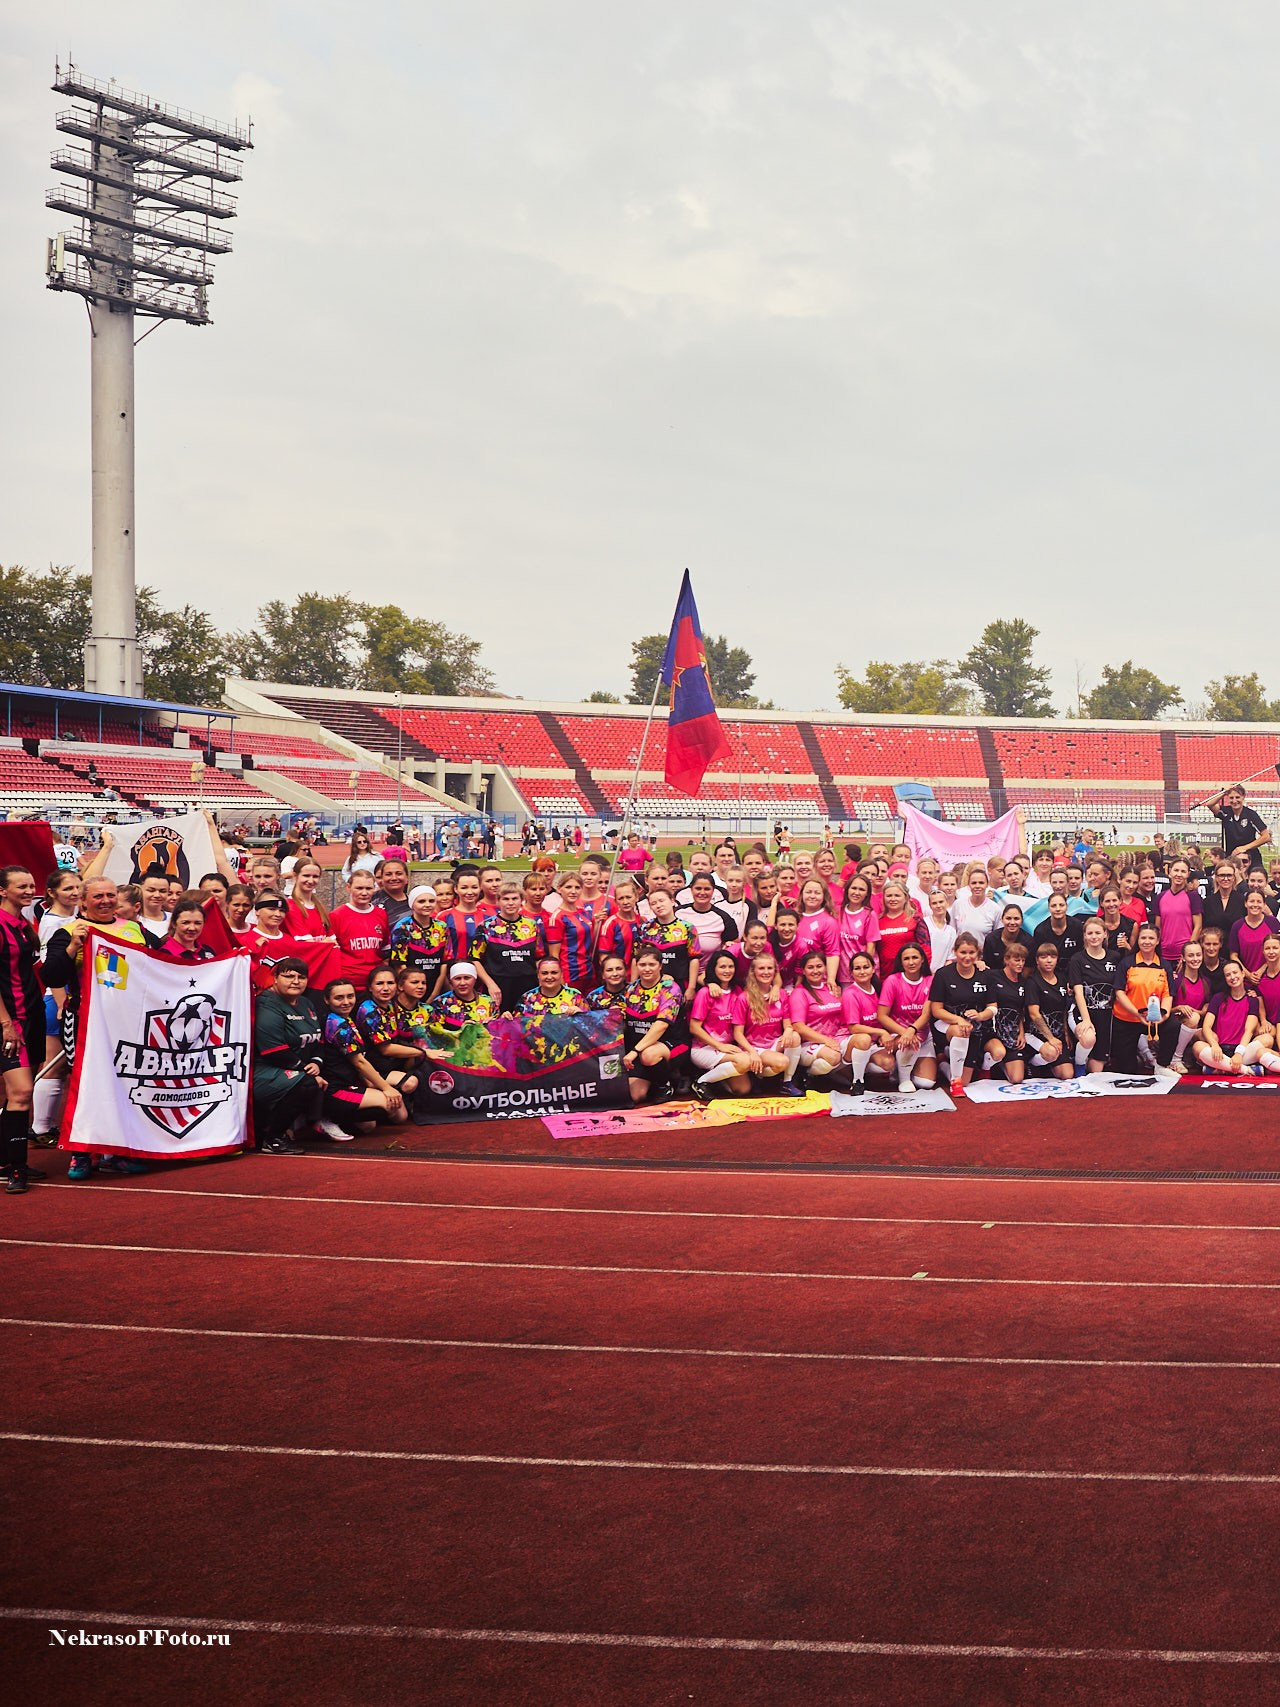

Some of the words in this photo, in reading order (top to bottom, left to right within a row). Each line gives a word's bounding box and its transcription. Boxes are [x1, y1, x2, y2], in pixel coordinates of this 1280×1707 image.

[135, 826, 184, 854] АВАНГАРД
[60, 851, 74, 864] 23
[151, 1090, 211, 1103] ДОМОДЕДОВО
[452, 1082, 598, 1110] ФУТБОЛЬНЫЕ
